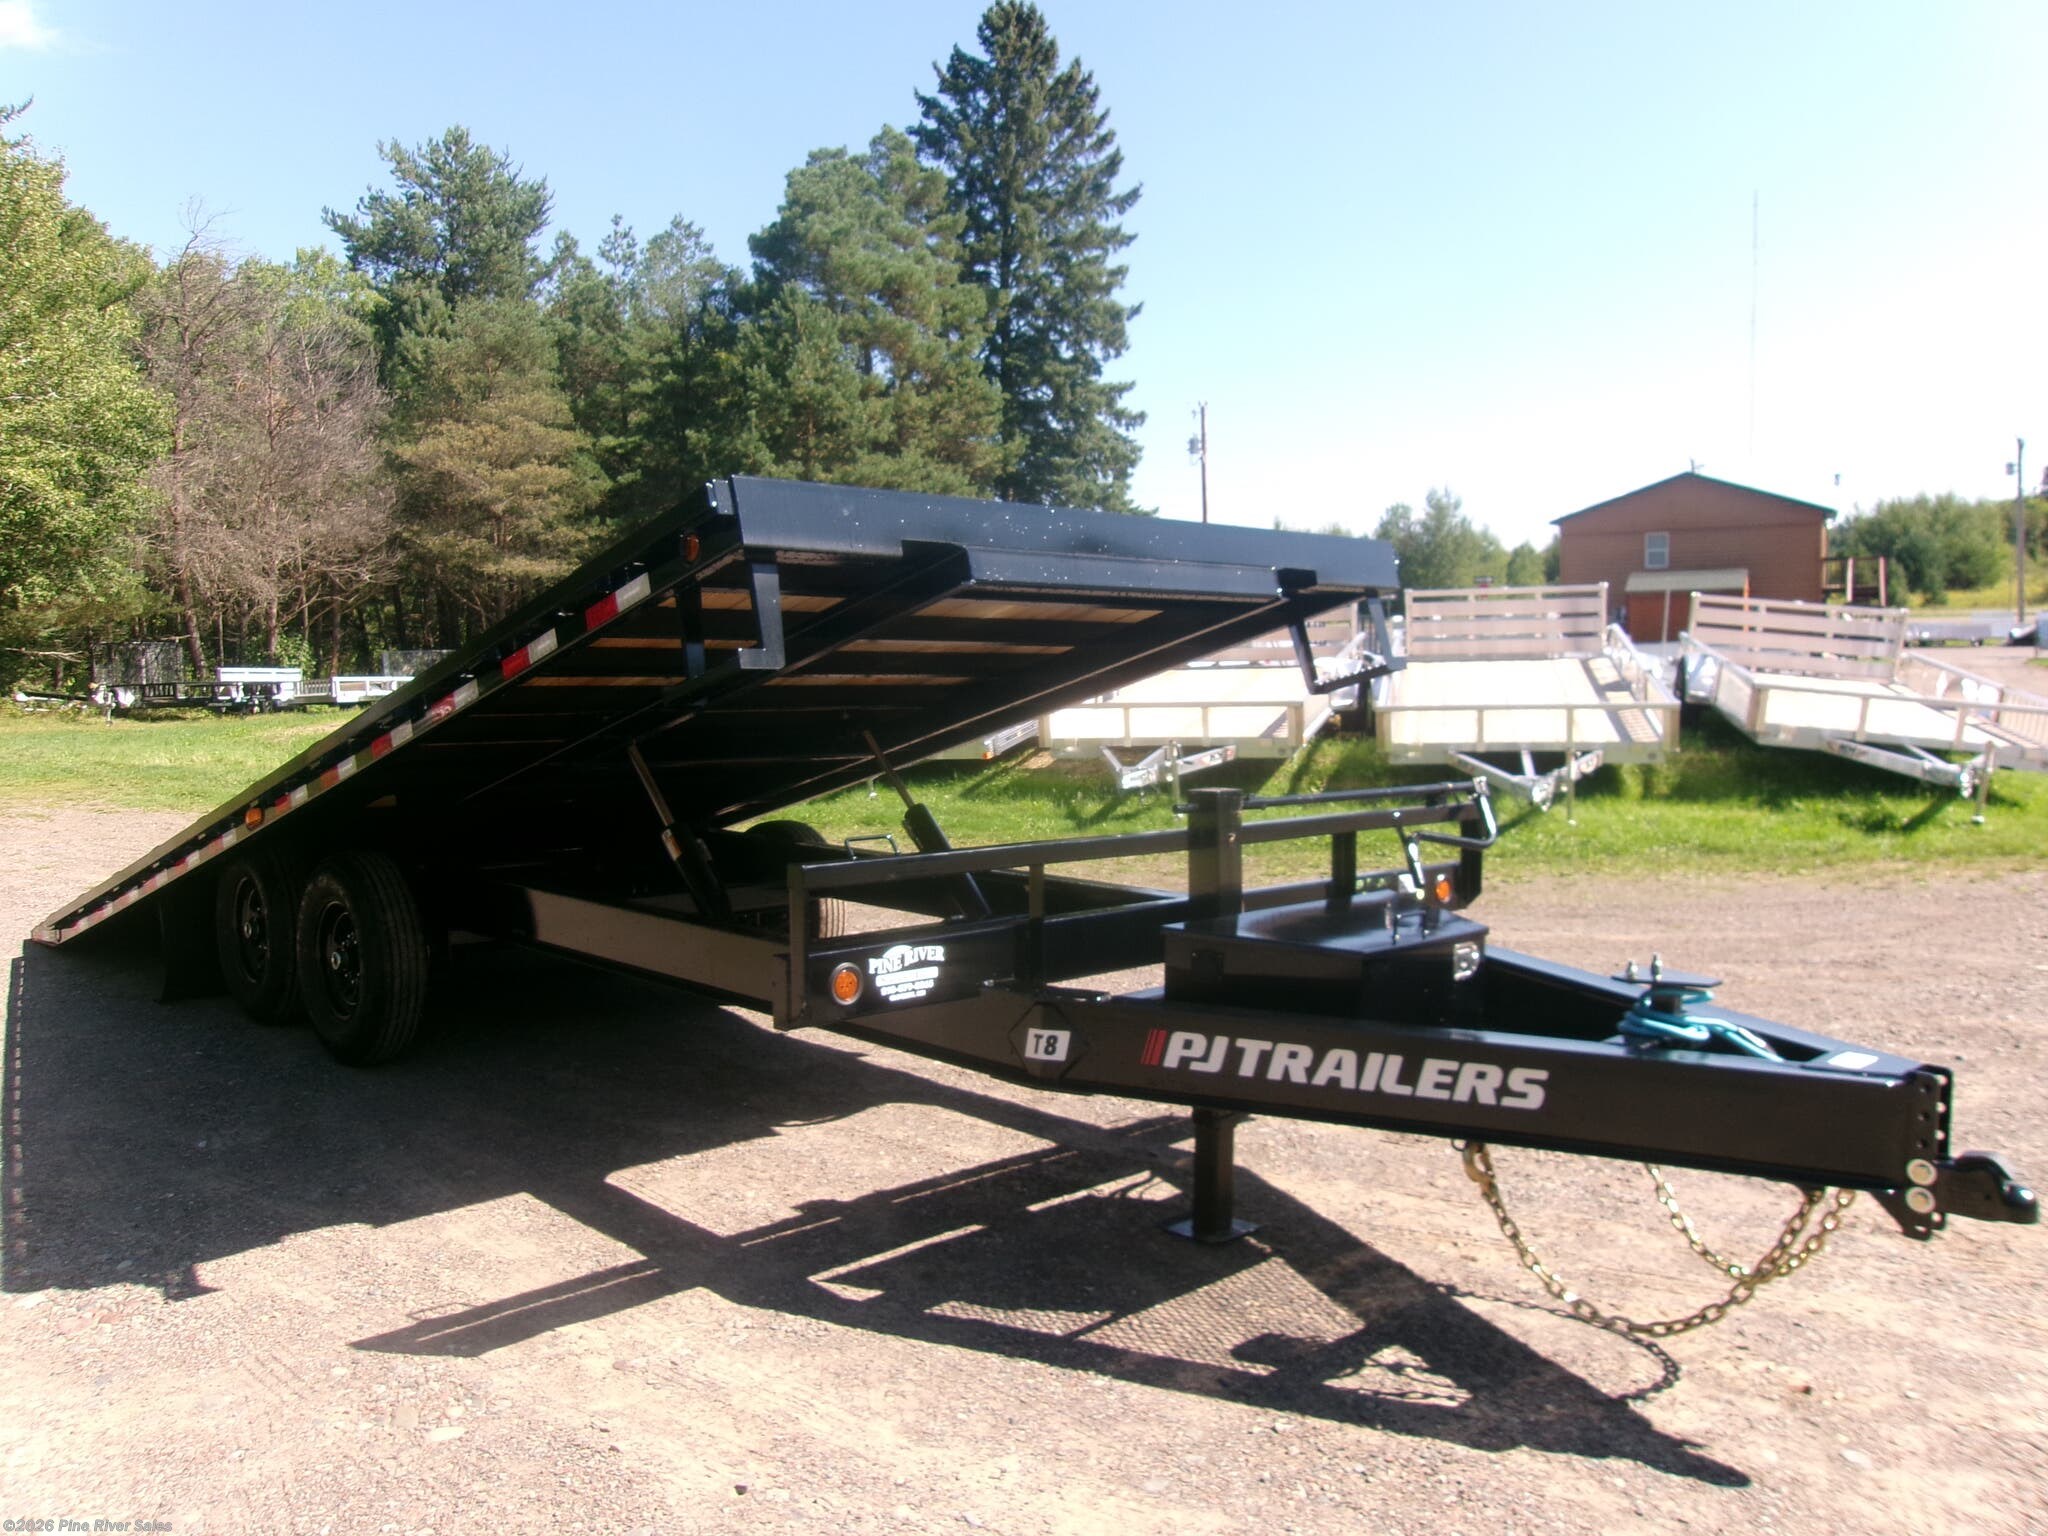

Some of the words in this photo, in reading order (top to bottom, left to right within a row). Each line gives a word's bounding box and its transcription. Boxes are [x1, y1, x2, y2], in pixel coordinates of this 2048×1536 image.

[869, 953, 903, 974] PINE
[904, 946, 945, 967] RIVER
[1033, 1033, 1059, 1056] T8
[1162, 1030, 1230, 1073] PJ
[1235, 1037, 1550, 1111] TRAILERS
